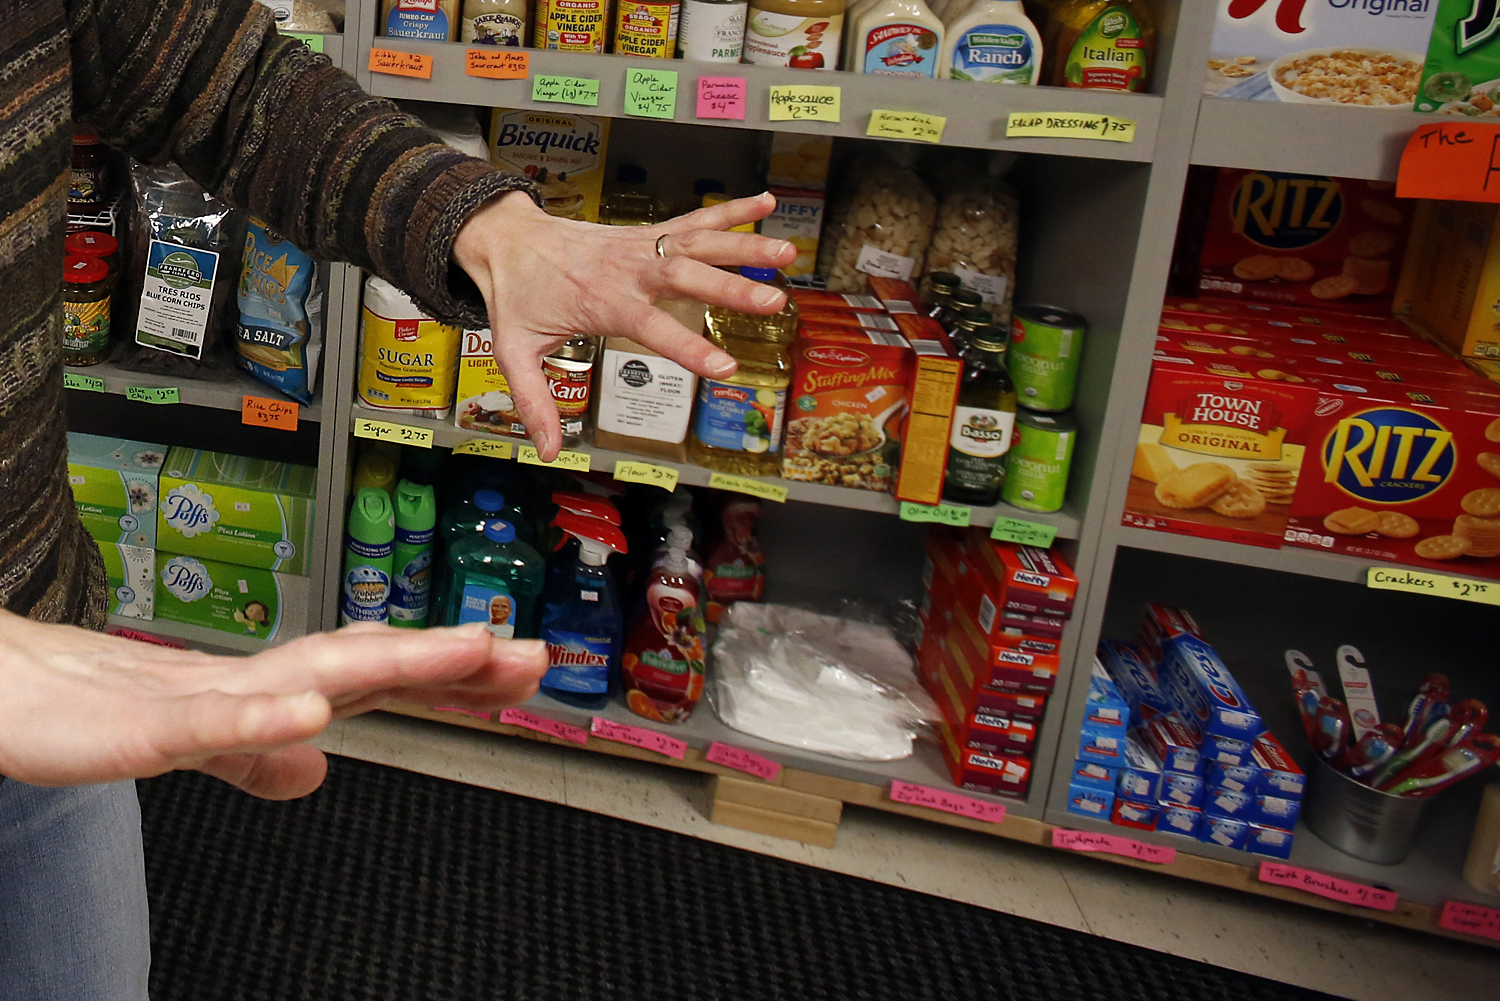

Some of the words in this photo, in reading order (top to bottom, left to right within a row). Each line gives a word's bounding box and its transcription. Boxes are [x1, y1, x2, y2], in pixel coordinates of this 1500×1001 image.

[402, 22, 430, 30] Crispy
[549, 14, 579, 22] APPLE
[579, 14, 603, 23] CIDER
[387, 28, 446, 40] Sauerkraut
[556, 23, 597, 32] VINEGAR
[623, 25, 659, 33] ORGANIC
[617, 35, 644, 44] APPLE
[644, 38, 666, 46] CIDER
[621, 44, 658, 54] VINEGAR
[968, 49, 1023, 65] Ranch
[1082, 46, 1136, 62] Italian
[630, 92, 666, 103] Vinegar
[1045, 118, 1100, 130] DRESSING
[496, 124, 601, 155] Bisquick
[1419, 129, 1475, 148] The
[1231, 171, 1342, 237] RITZ
[145, 292, 162, 300] BLUE
[161, 295, 183, 305] CORN
[182, 301, 206, 311] CHIPS
[158, 286, 178, 295] TRES
[179, 291, 202, 301] RIOS
[254, 331, 285, 347] SALT
[377, 347, 435, 367] SUGAR
[802, 370, 868, 393] Stuffing
[865, 364, 899, 382] Mix
[831, 400, 869, 410] CHICKEN
[1196, 393, 1264, 416] TOWN
[1191, 407, 1262, 431] HOUSE
[363, 422, 391, 438] Sugar
[961, 427, 1002, 441] Basso
[1178, 433, 1263, 454] ORIGINAL
[1323, 418, 1454, 488] RITZ
[619, 466, 649, 478] Flour
[1379, 480, 1427, 490] CRACKERS
[168, 494, 210, 527] Puffs
[216, 526, 234, 538] Plus
[234, 530, 257, 538] Lotion
[168, 565, 204, 593] Puffs
[1015, 573, 1049, 586] Hefty
[1373, 572, 1436, 590] Crackers
[547, 643, 610, 668] Windex
[1000, 651, 1034, 665] Hefty
[969, 754, 1003, 769] Hefty
[1266, 867, 1298, 880] Tooth
[1303, 874, 1350, 896] Brushes
